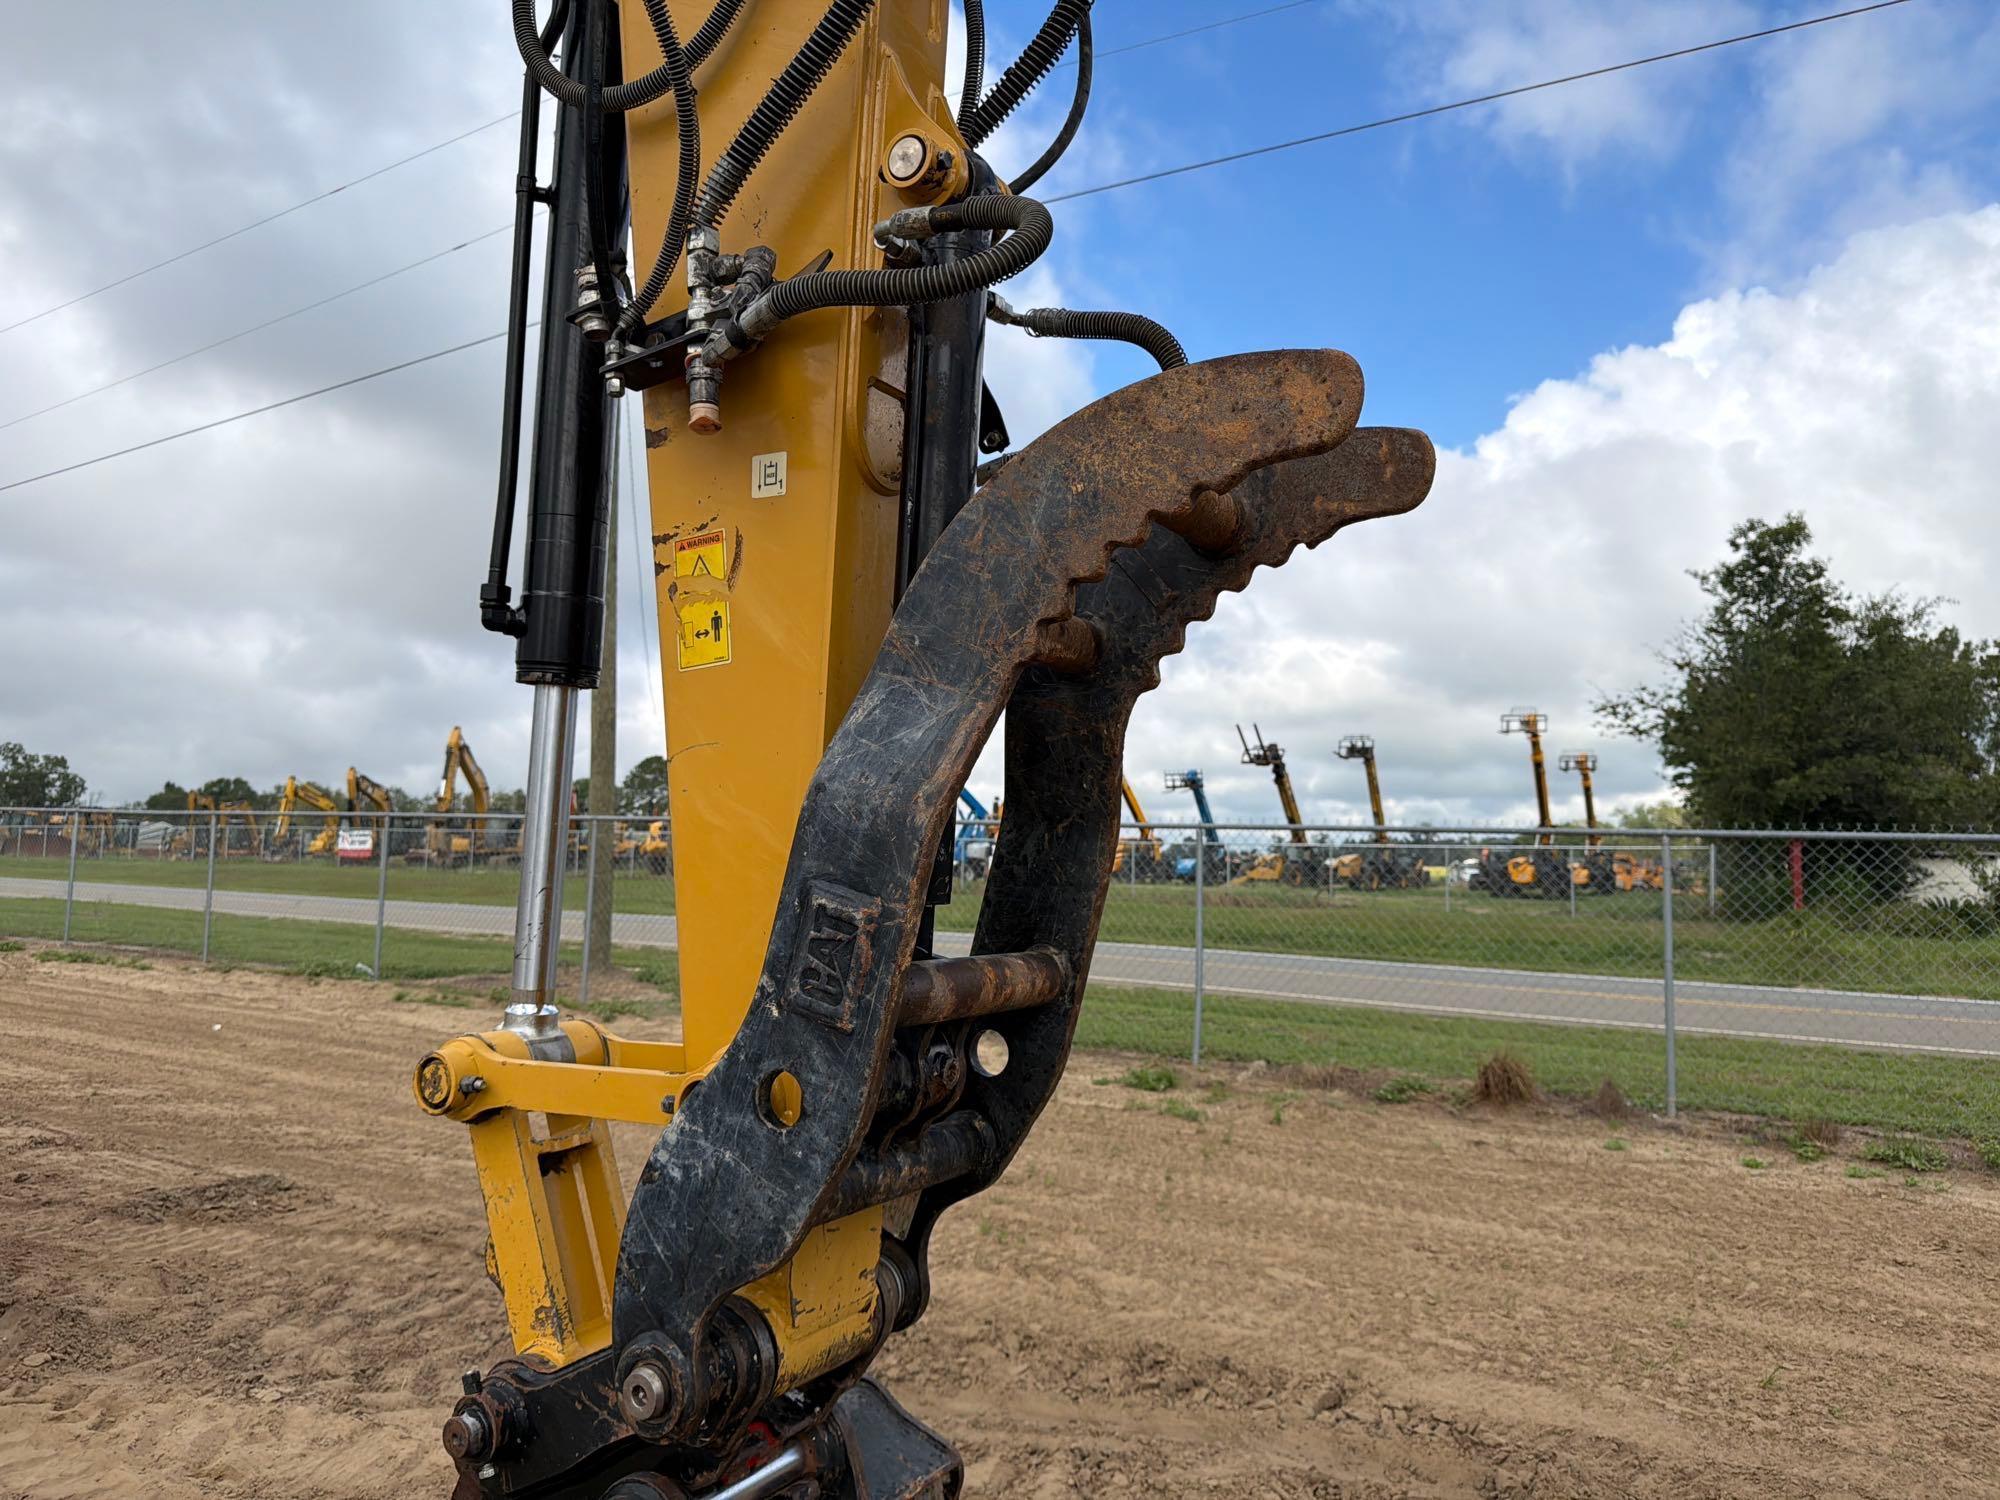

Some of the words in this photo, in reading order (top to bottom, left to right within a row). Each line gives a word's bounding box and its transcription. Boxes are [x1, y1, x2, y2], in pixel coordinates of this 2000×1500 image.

[778, 479, 783, 490] 1
[686, 534, 721, 549] WARNING
[799, 903, 859, 1008] CAT
